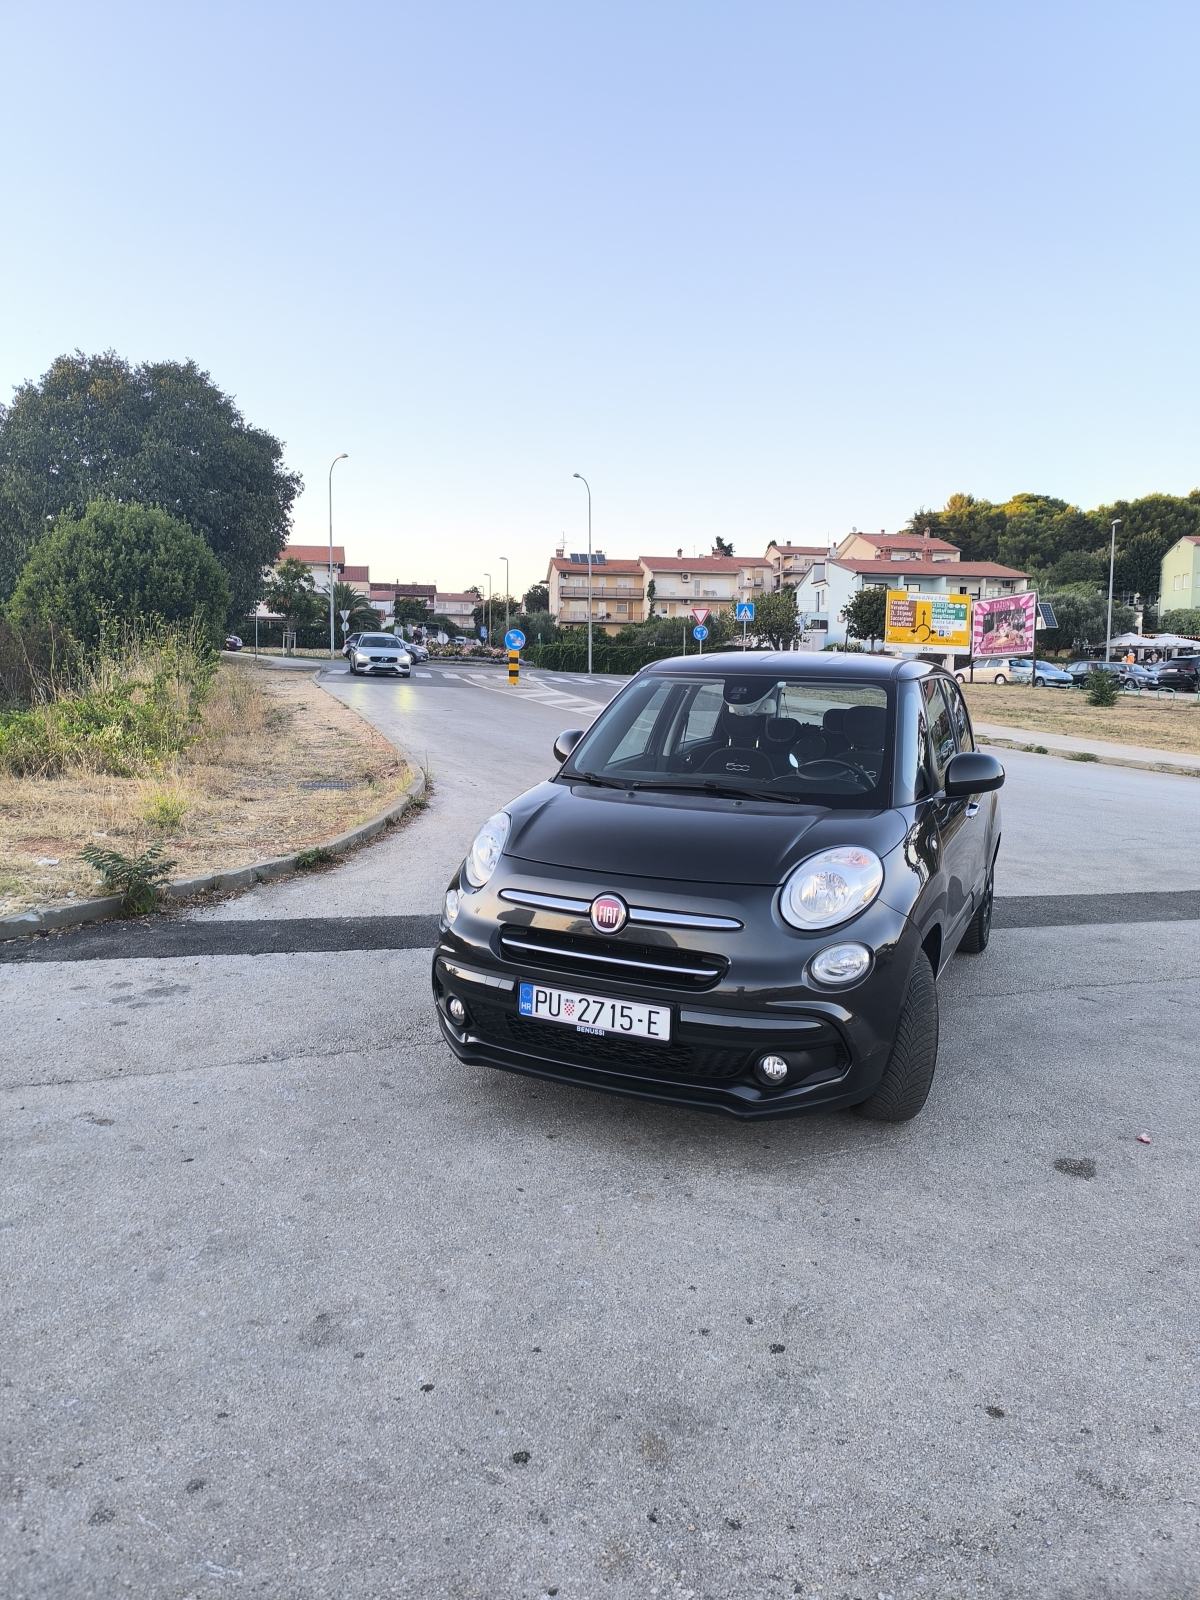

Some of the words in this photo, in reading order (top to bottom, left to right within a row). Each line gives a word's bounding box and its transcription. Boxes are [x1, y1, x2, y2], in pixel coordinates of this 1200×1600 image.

[598, 905, 619, 924] FIAT
[521, 1002, 532, 1011] HR
[535, 989, 562, 1017] PU
[577, 997, 660, 1036] 2715-E
[576, 1025, 605, 1037] BENUSSI
